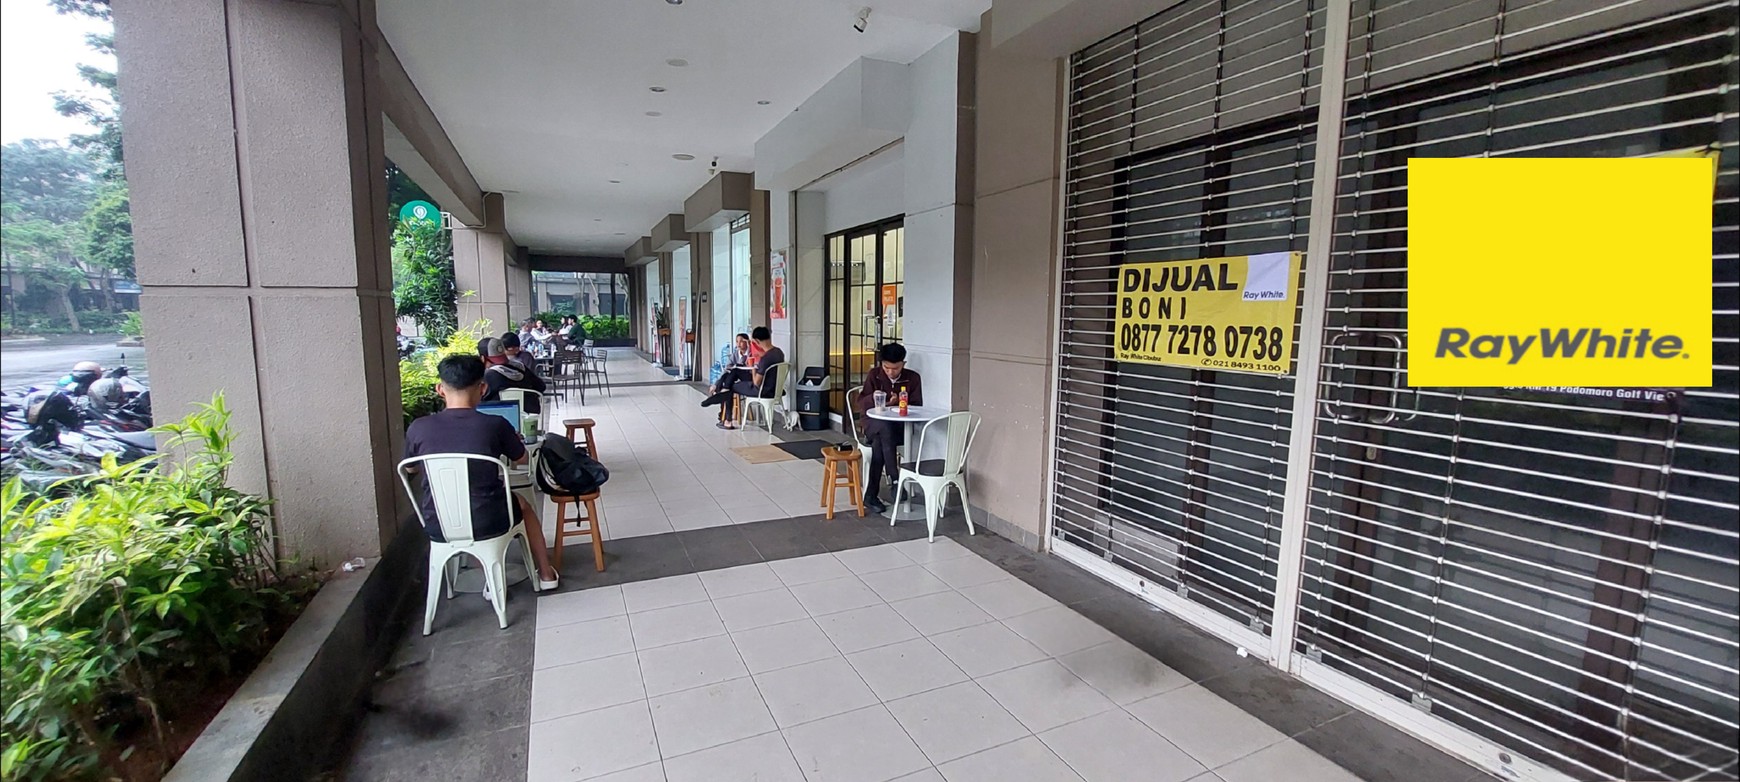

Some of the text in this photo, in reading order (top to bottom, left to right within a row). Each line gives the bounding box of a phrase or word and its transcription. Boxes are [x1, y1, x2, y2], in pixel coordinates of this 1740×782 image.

[1123, 263, 1239, 293] DIJUAL
[1243, 291, 1260, 300] Ray
[1122, 297, 1187, 320] BONI
[1121, 323, 1283, 362] 0877 7278 0738
[1213, 360, 1281, 372] 021 8493 1100
[1616, 389, 1641, 400] Golf
